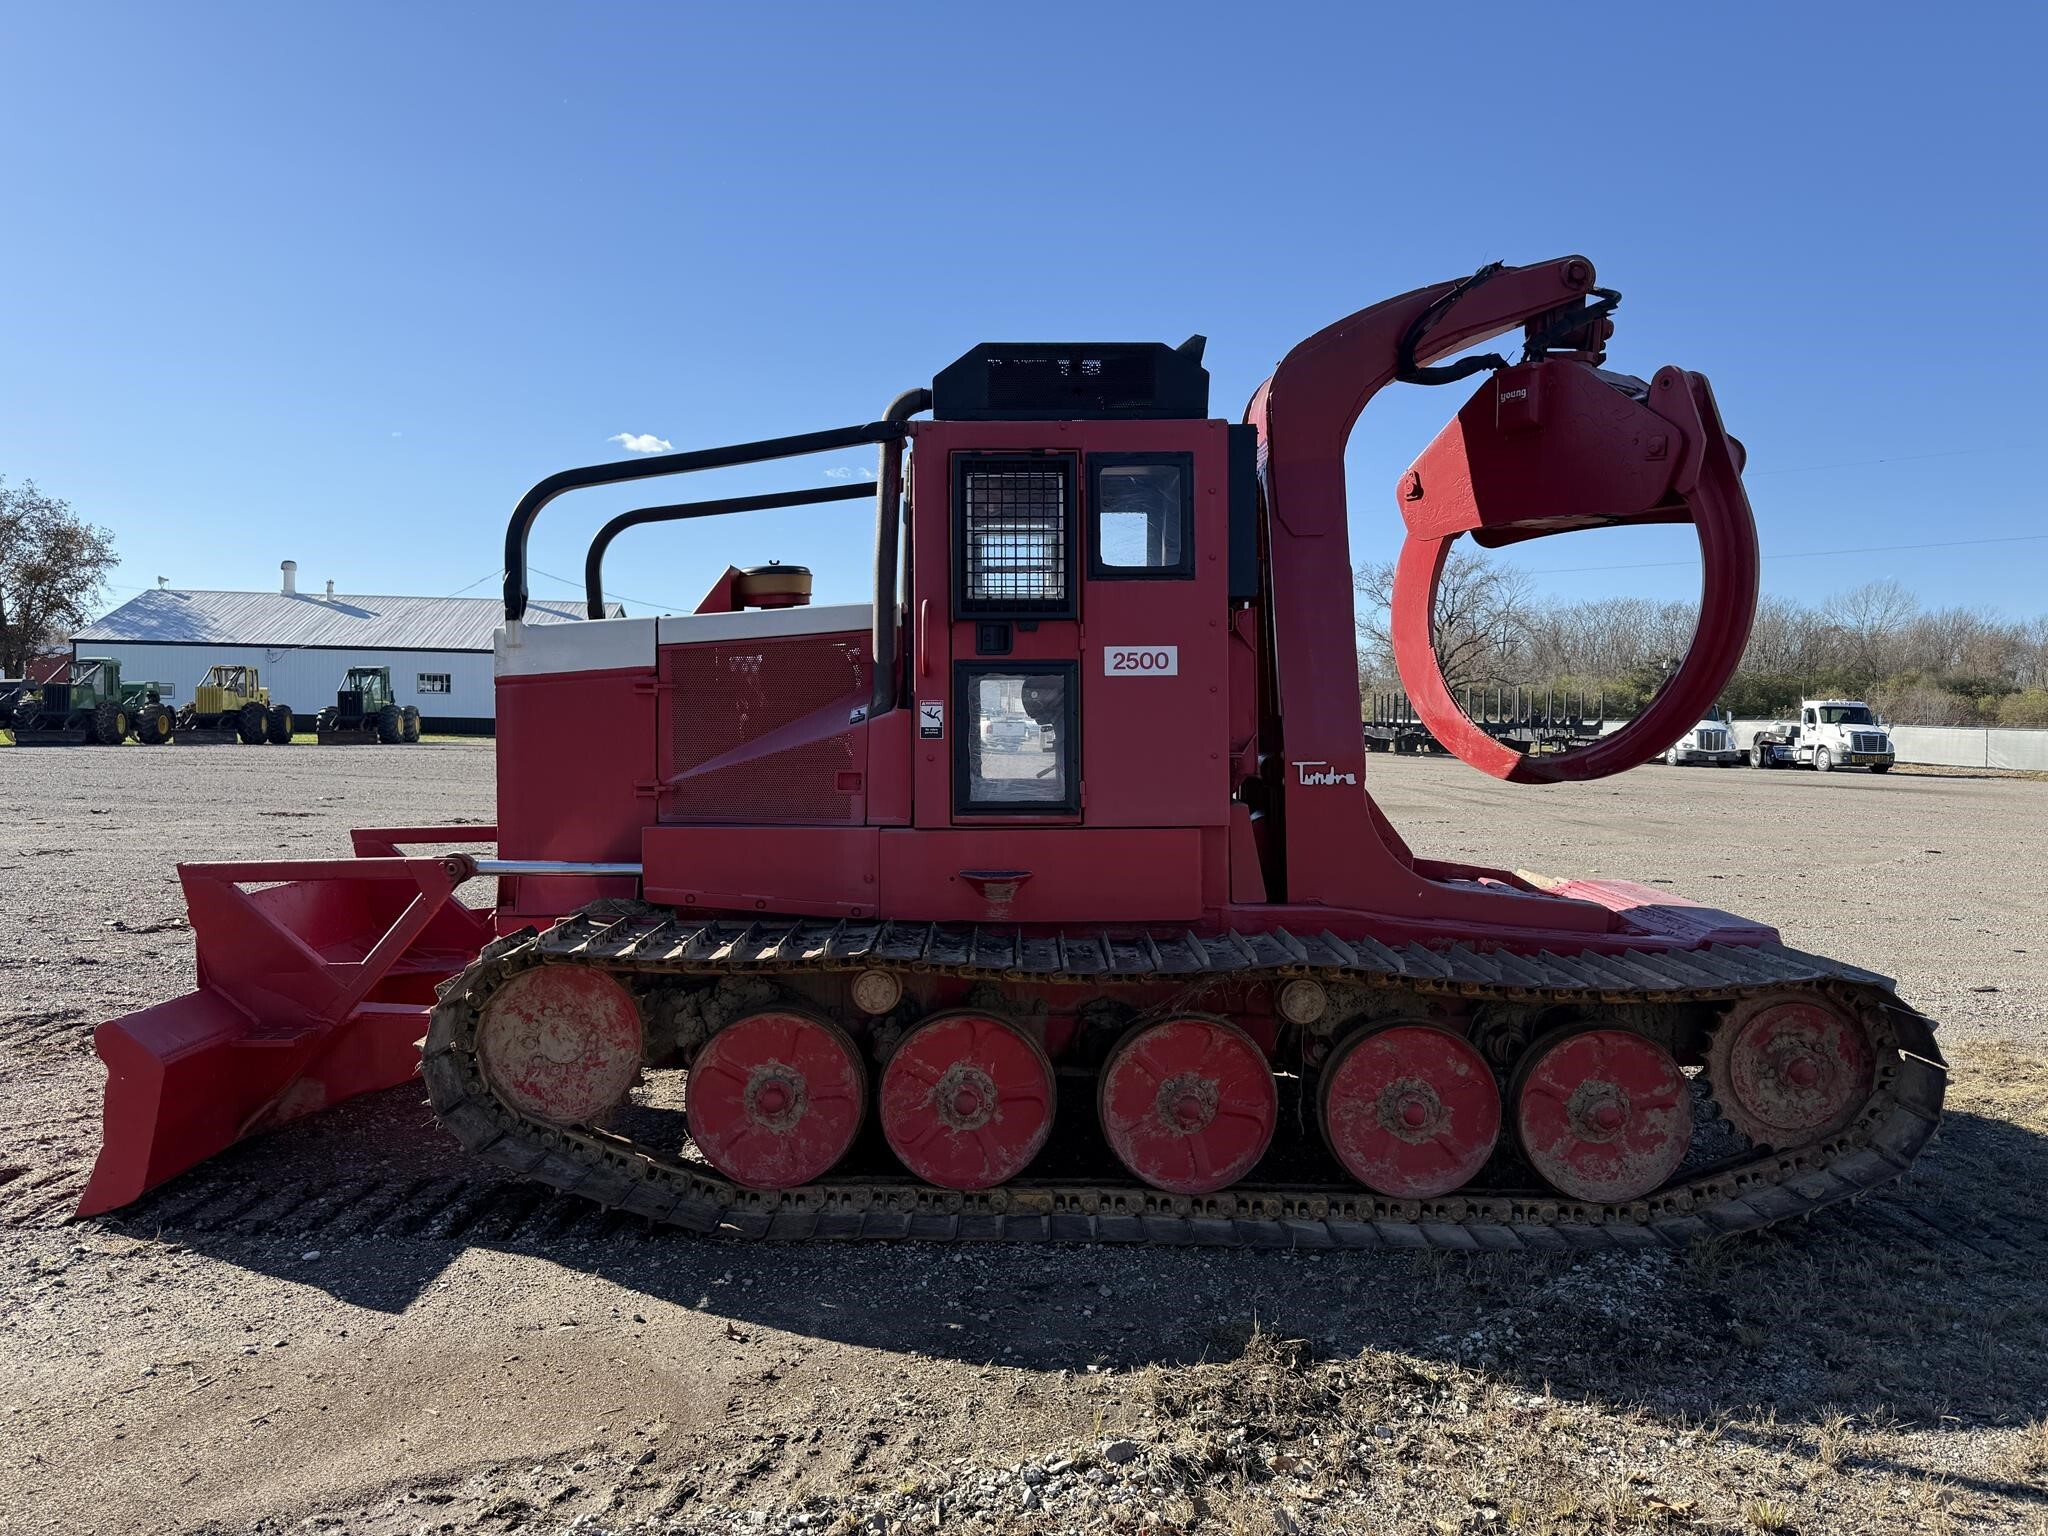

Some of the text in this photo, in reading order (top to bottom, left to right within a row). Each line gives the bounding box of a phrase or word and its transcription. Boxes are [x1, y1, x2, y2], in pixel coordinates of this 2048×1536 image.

[1500, 388, 1527, 403] young
[1113, 652, 1169, 670] 2500
[1292, 761, 1357, 785] Tundra
